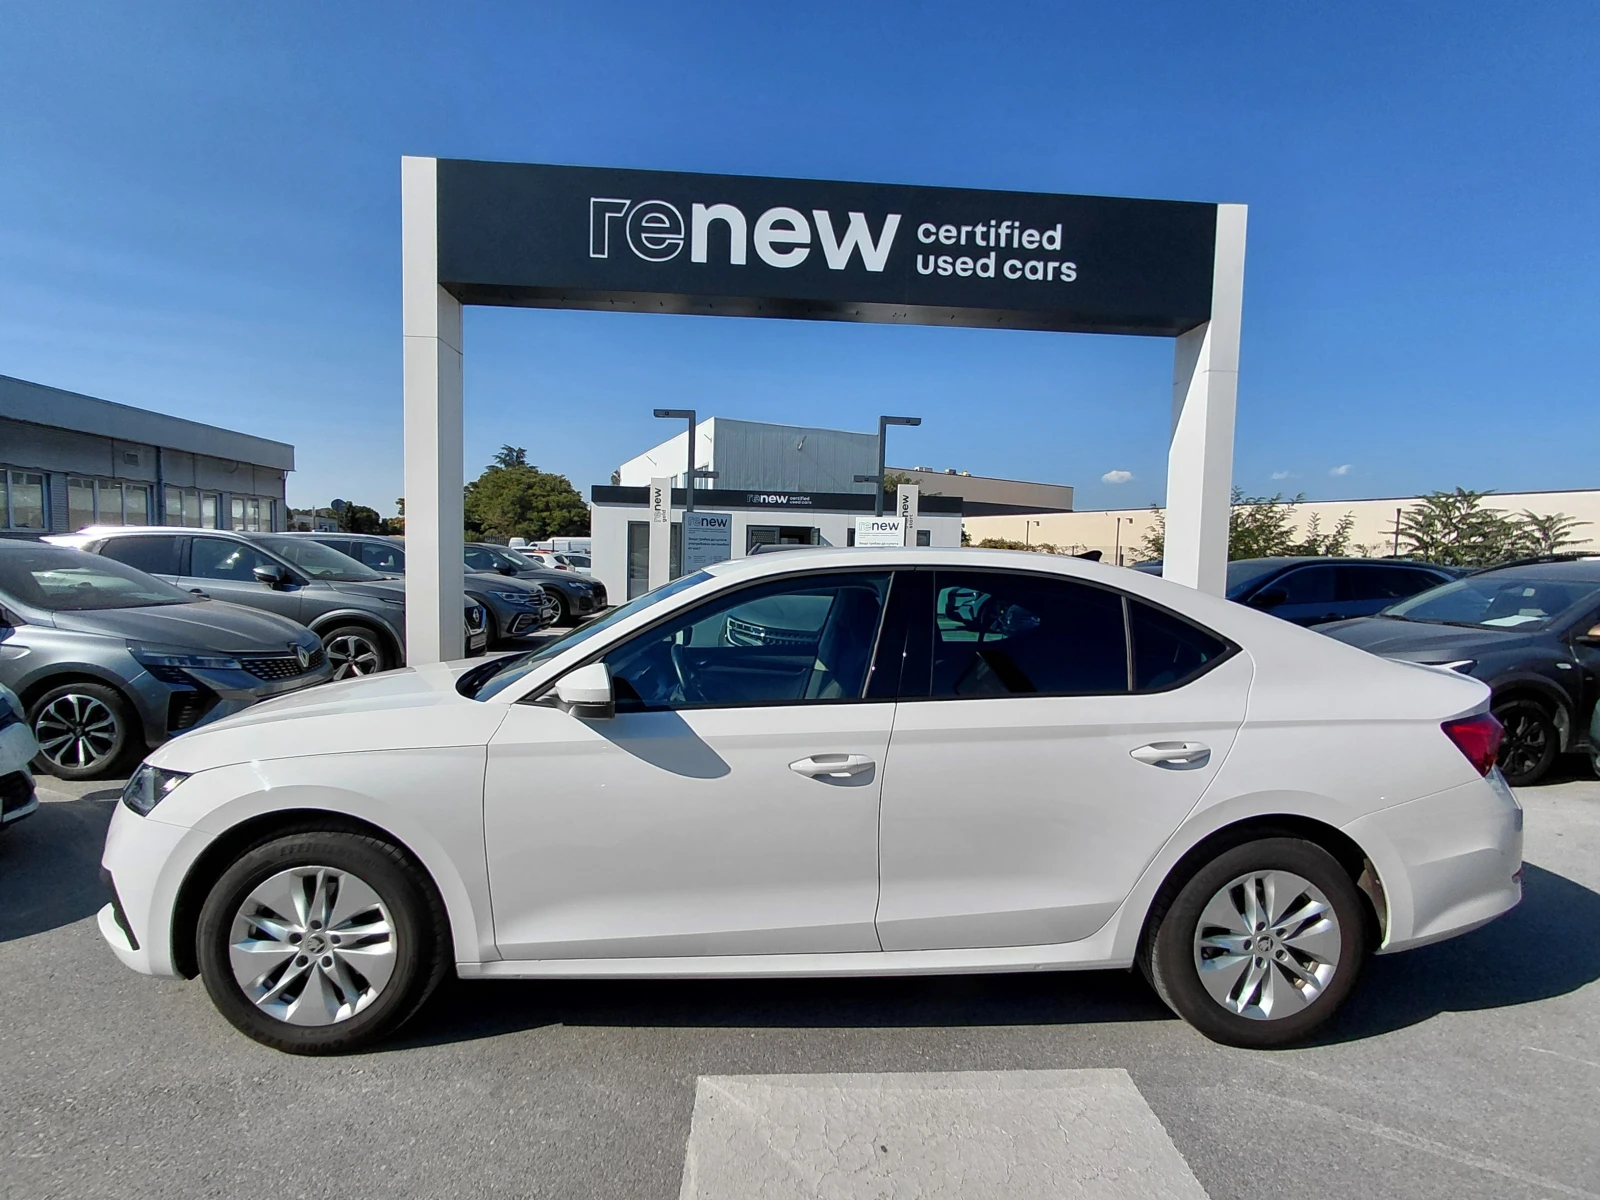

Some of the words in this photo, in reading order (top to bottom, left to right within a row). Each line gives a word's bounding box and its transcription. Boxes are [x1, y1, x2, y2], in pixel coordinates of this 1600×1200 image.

[588, 197, 901, 272] renew
[916, 219, 1062, 251] certified
[916, 251, 996, 278] used
[1003, 259, 1077, 282] cars
[746, 494, 789, 504] renew
[687, 516, 728, 527] renew
[858, 521, 900, 532] renew
